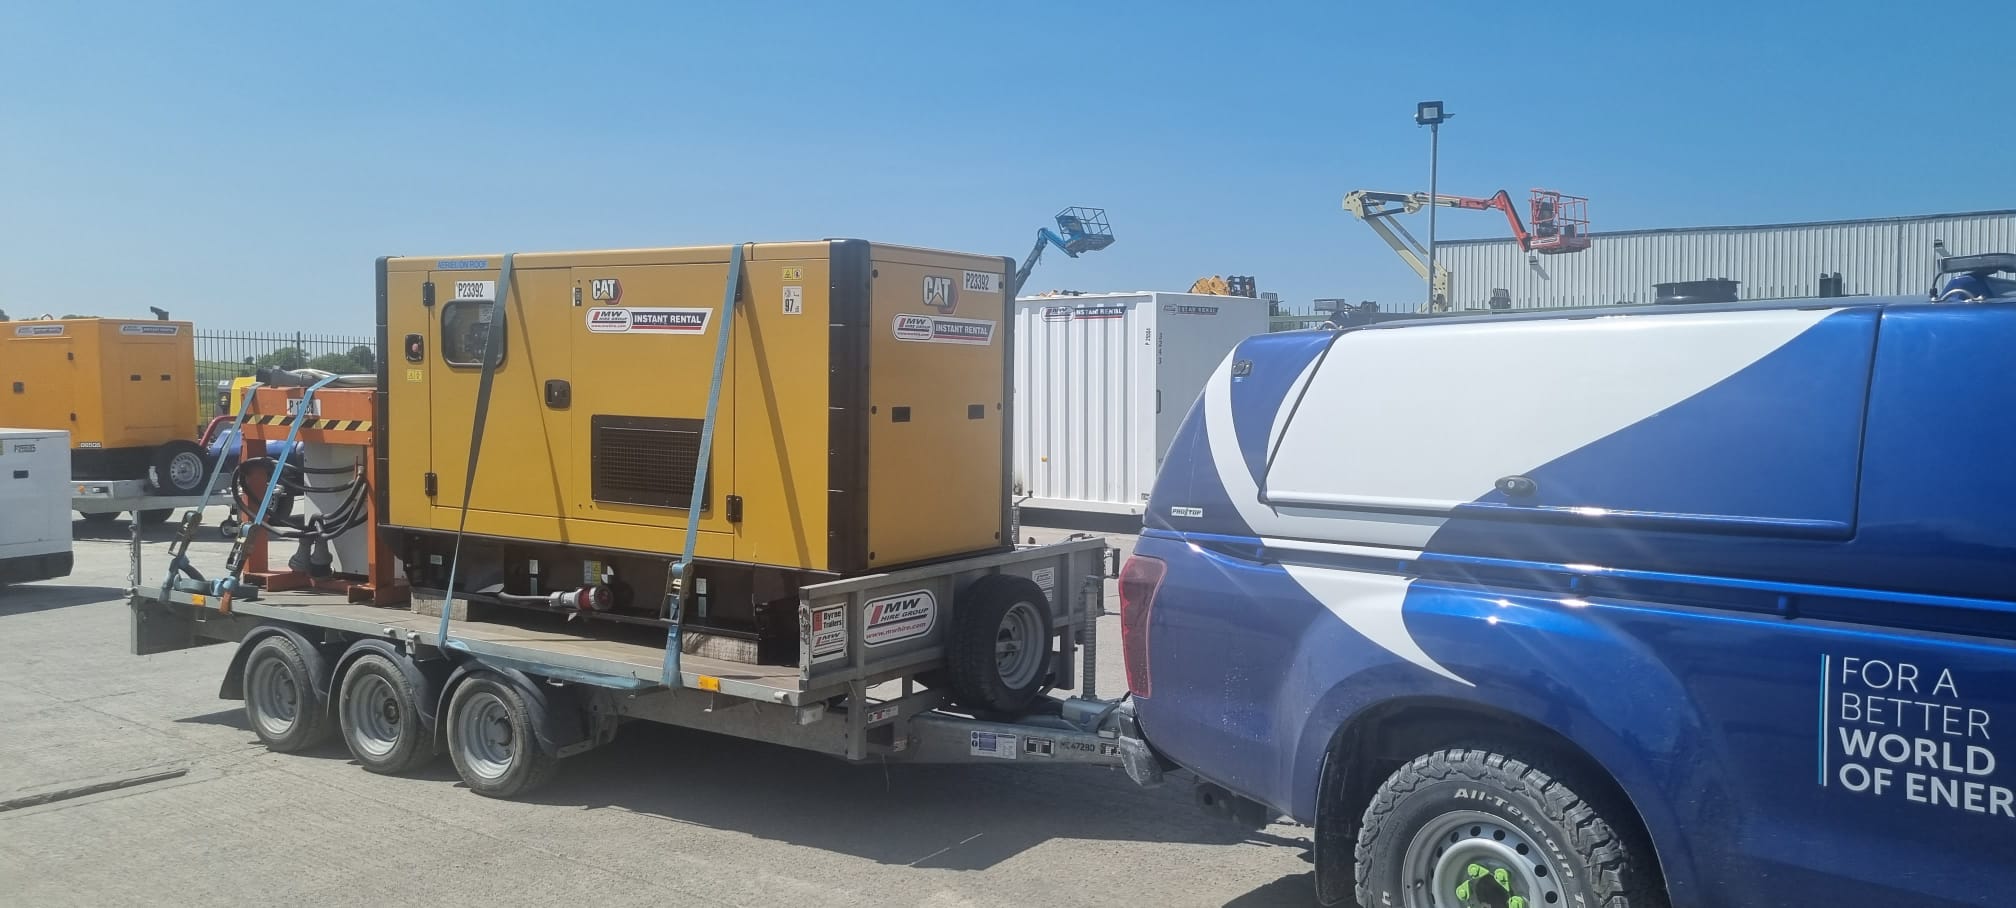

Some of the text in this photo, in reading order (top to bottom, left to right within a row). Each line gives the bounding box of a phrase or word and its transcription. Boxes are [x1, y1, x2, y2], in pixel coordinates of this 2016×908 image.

[592, 279, 616, 300] CAT
[965, 272, 990, 291] P23392
[458, 283, 484, 298] P23392
[923, 276, 951, 307] CAT
[785, 299, 794, 312] 97
[634, 314, 702, 324] INSTANT RENTAL
[935, 323, 988, 335] INSTANT RENTAL
[883, 597, 921, 614] MW
[823, 610, 842, 622] Byrne
[880, 607, 929, 622] HIRE GROUP
[823, 619, 842, 629] Trailers
[865, 622, 927, 639] www.mwhire.com
[1842, 656, 1958, 698] FOR A
[1841, 692, 1990, 740] BETTER
[1838, 726, 1996, 776] WORLD
[1839, 763, 2016, 818] OF ENER
[1453, 788, 1575, 879] All-Terrain
